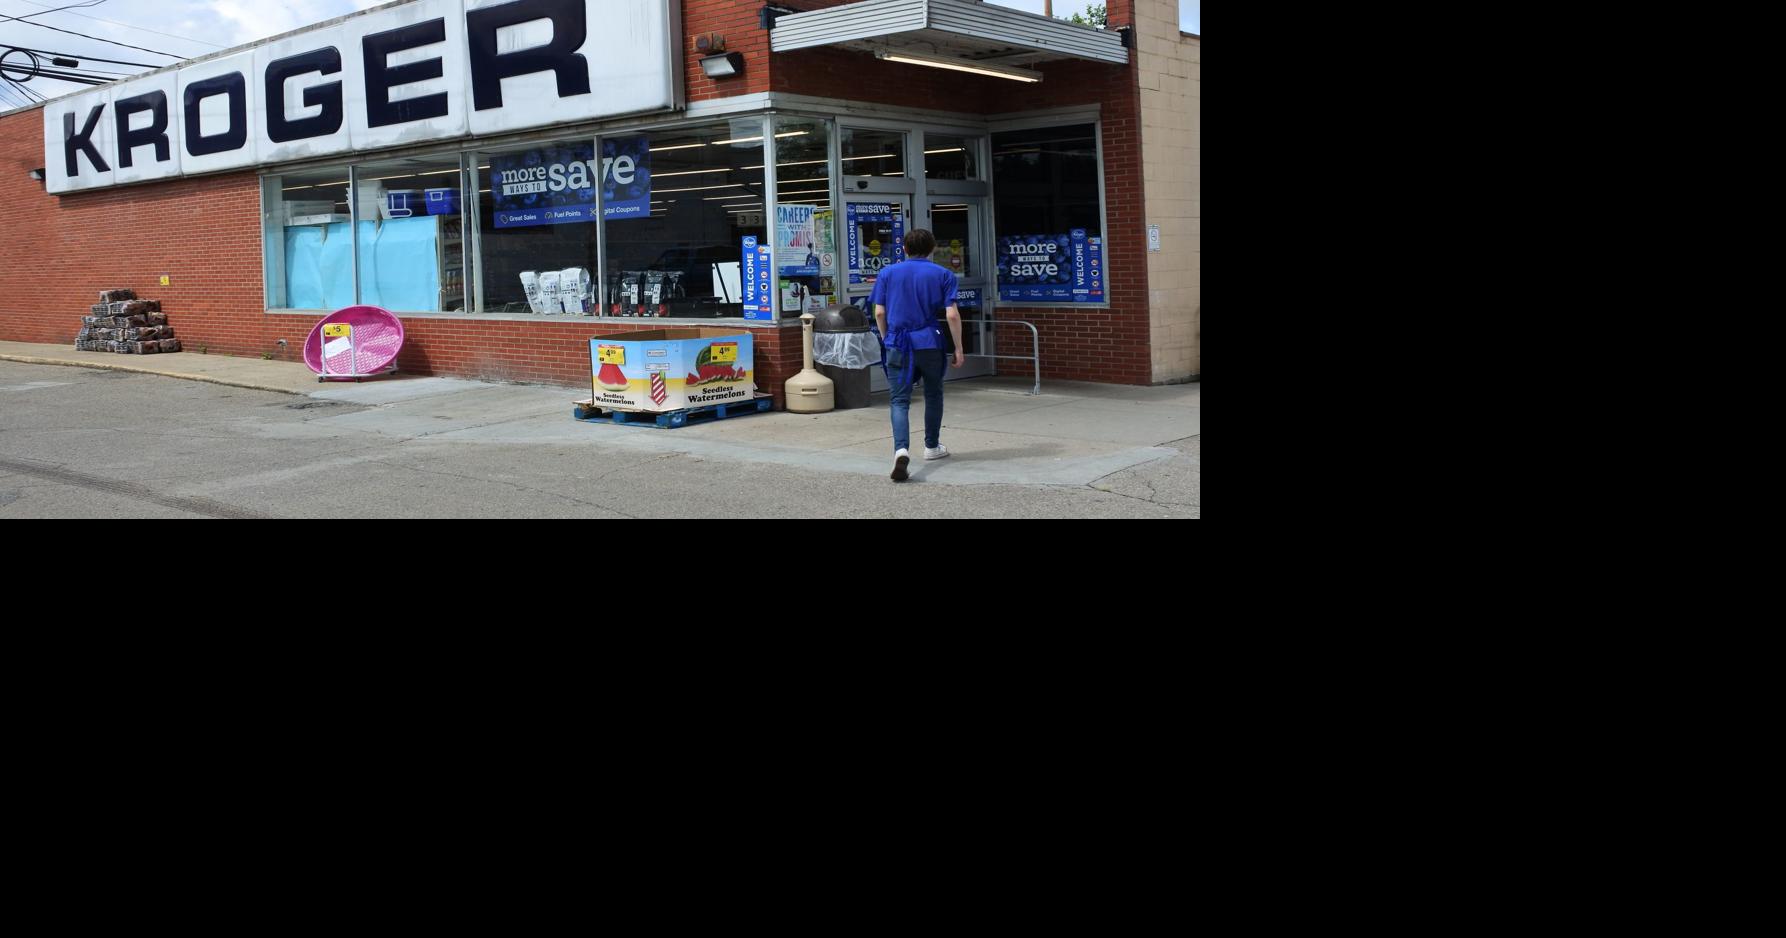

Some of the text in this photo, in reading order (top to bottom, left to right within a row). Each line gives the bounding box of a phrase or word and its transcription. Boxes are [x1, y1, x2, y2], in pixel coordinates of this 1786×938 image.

[64, 0, 592, 177] KROGER
[502, 166, 547, 183] more
[548, 155, 635, 191] save
[509, 182, 541, 193] WAYS TO
[615, 205, 640, 214] Coupons
[868, 204, 890, 214] save
[848, 219, 856, 266] WELCOME
[1009, 243, 1057, 254] more
[1011, 263, 1058, 276] save
[1075, 243, 1085, 286] WELCOME
[746, 252, 755, 302] WELCOME
[956, 290, 975, 299] save
[688, 390, 746, 403] Watermelons
[702, 386, 733, 394] Seedless
[595, 396, 635, 405] Watermelons
